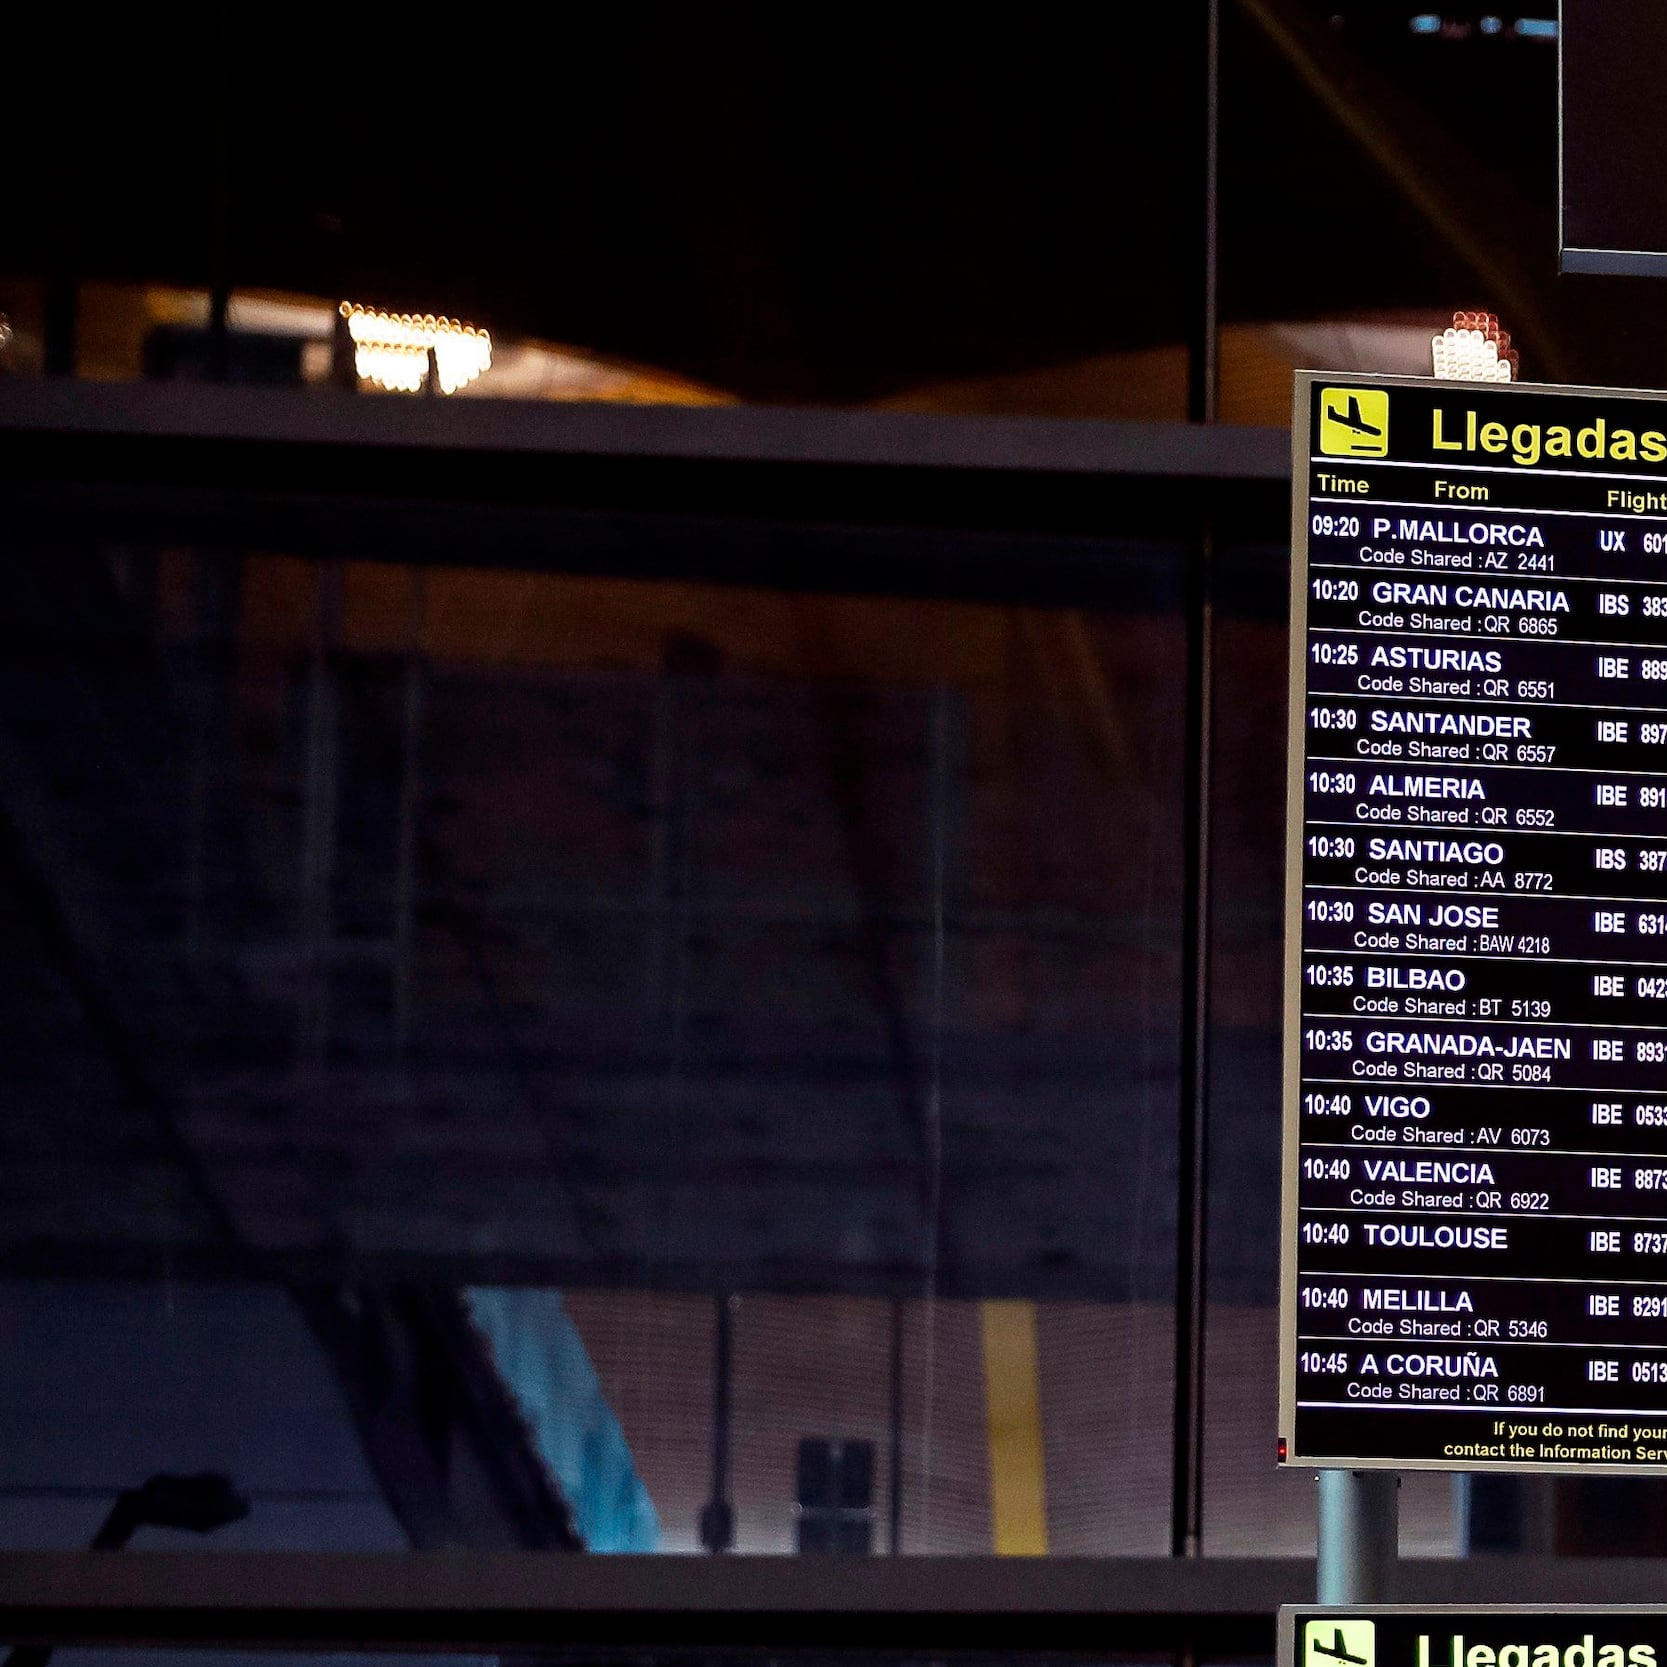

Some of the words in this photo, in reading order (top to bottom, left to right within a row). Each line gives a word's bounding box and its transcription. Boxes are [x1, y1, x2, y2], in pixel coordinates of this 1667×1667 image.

[1433, 409, 1667, 465] Llegadas
[1317, 474, 1369, 493] Time
[1435, 481, 1488, 500] From
[1608, 491, 1667, 513] Flight
[1313, 515, 1359, 537] 09:20
[1374, 518, 1544, 547] P.MALLORCA
[1601, 530, 1625, 551] UX
[1360, 547, 1403, 564] Code
[1411, 549, 1472, 568] Shared
[1518, 553, 1554, 571] 2441
[1313, 579, 1358, 600] 10:20
[1373, 582, 1446, 605] GRAN
[1459, 586, 1569, 612] CANARIA
[1600, 594, 1629, 615] IBS
